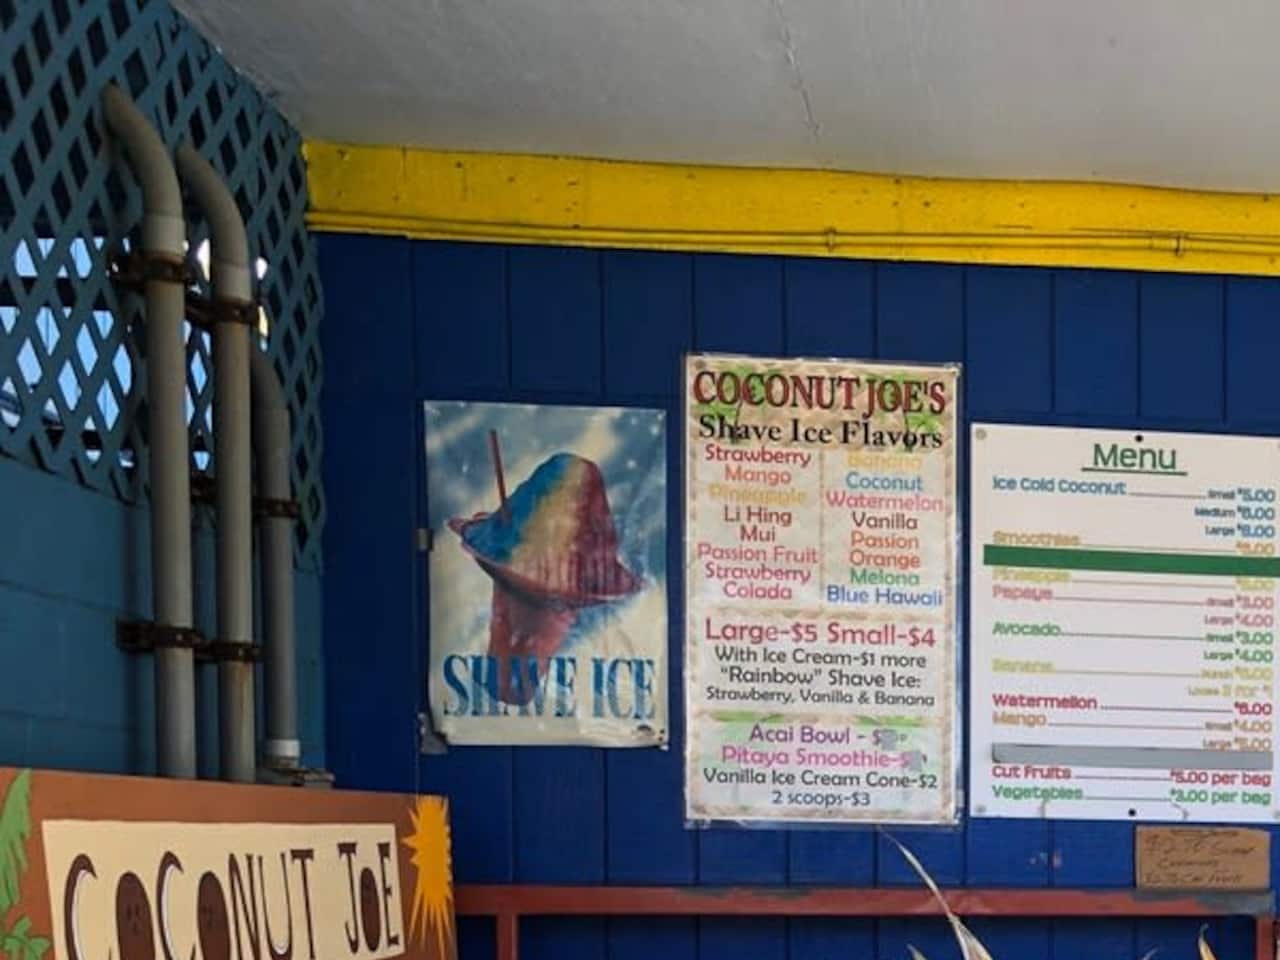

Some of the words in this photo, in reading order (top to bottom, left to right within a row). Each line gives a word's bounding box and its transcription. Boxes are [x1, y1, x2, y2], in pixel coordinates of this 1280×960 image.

[693, 371, 860, 410] COCONUT
[861, 378, 946, 418] JOE'S
[700, 414, 781, 443] Shave
[791, 418, 832, 443] Ice
[840, 420, 943, 448] Flavors
[705, 444, 811, 468] Strawberry
[1093, 442, 1177, 469] Menu
[725, 464, 791, 486] Mango
[846, 472, 922, 490] Coconut
[992, 477, 1017, 490] Ice
[1020, 478, 1054, 492] Cold
[1058, 480, 1127, 495] Coconut
[826, 490, 944, 511] Watermelon
[724, 507, 741, 522] Li
[747, 507, 792, 527] Hing
[852, 512, 918, 530] Vanilla
[740, 525, 776, 542] Mui
[851, 531, 919, 549] Passion
[697, 544, 768, 563] Passion
[774, 546, 818, 564] Fruit
[850, 551, 921, 570] Orange
[705, 562, 812, 585] Strawberry
[850, 569, 920, 585] Melona
[723, 581, 792, 600] Colada
[827, 585, 870, 602] Blue
[876, 588, 943, 606] Hawaii
[705, 618, 818, 645] Large-$5
[827, 622, 936, 648] Small-$4
[992, 621, 1062, 636] Avocado
[714, 645, 758, 663] With
[763, 648, 787, 664] Ice
[792, 649, 875, 667] Cream-$1
[880, 655, 926, 668] more
[444, 655, 577, 717] SHAVE
[591, 658, 655, 718] ICE
[828, 669, 885, 688] Shave
[891, 671, 921, 688] Ice:
[706, 686, 794, 704] Strawberry,
[799, 689, 852, 704] Vanilla
[858, 692, 870, 705] &
[875, 691, 935, 707] Banana
[749, 725, 794, 743] Acai
[801, 727, 850, 745] Bowl
[721, 746, 789, 767] Pitaya
[703, 768, 767, 785] Vanilla
[771, 769, 796, 786] Ice
[801, 771, 860, 787] Cream
[865, 772, 938, 789] Cone-$2
[992, 765, 1020, 778] Cut
[1024, 765, 1072, 780] Fruits
[1212, 773, 1239, 785] per
[1242, 773, 1272, 788] bag
[772, 791, 783, 804] 2
[787, 791, 871, 808] scoops-$3
[992, 784, 1083, 800] Vegetables
[1212, 791, 1239, 805] per
[1242, 791, 1272, 806] bag
[337, 842, 400, 954] JOE
